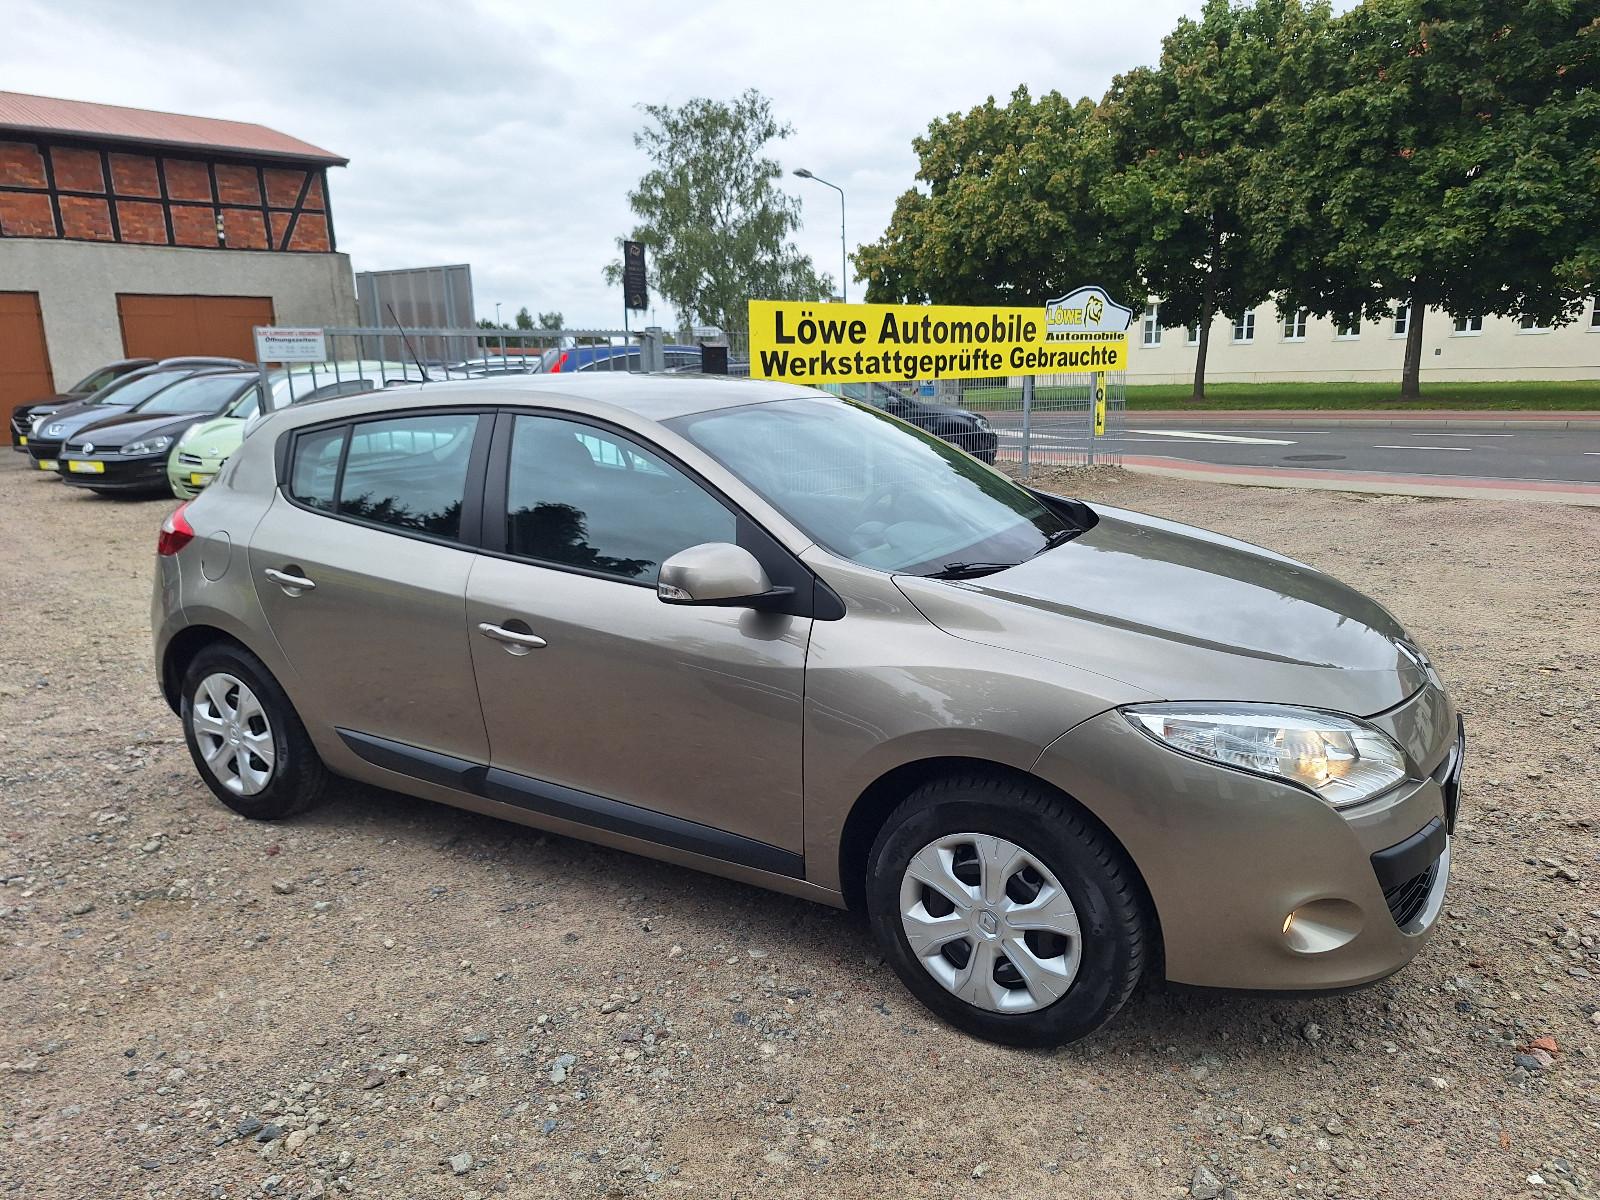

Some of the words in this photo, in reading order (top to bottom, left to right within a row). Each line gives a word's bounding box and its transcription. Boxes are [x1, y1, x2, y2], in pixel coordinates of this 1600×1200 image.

[775, 311, 867, 345] Löwe
[878, 312, 1037, 345] Automobile
[1047, 305, 1083, 326] LÖWE
[1046, 332, 1125, 342] Automobile
[760, 349, 1003, 379] Werkstattgeprüfte
[1009, 345, 1118, 369] Gebrauchte
